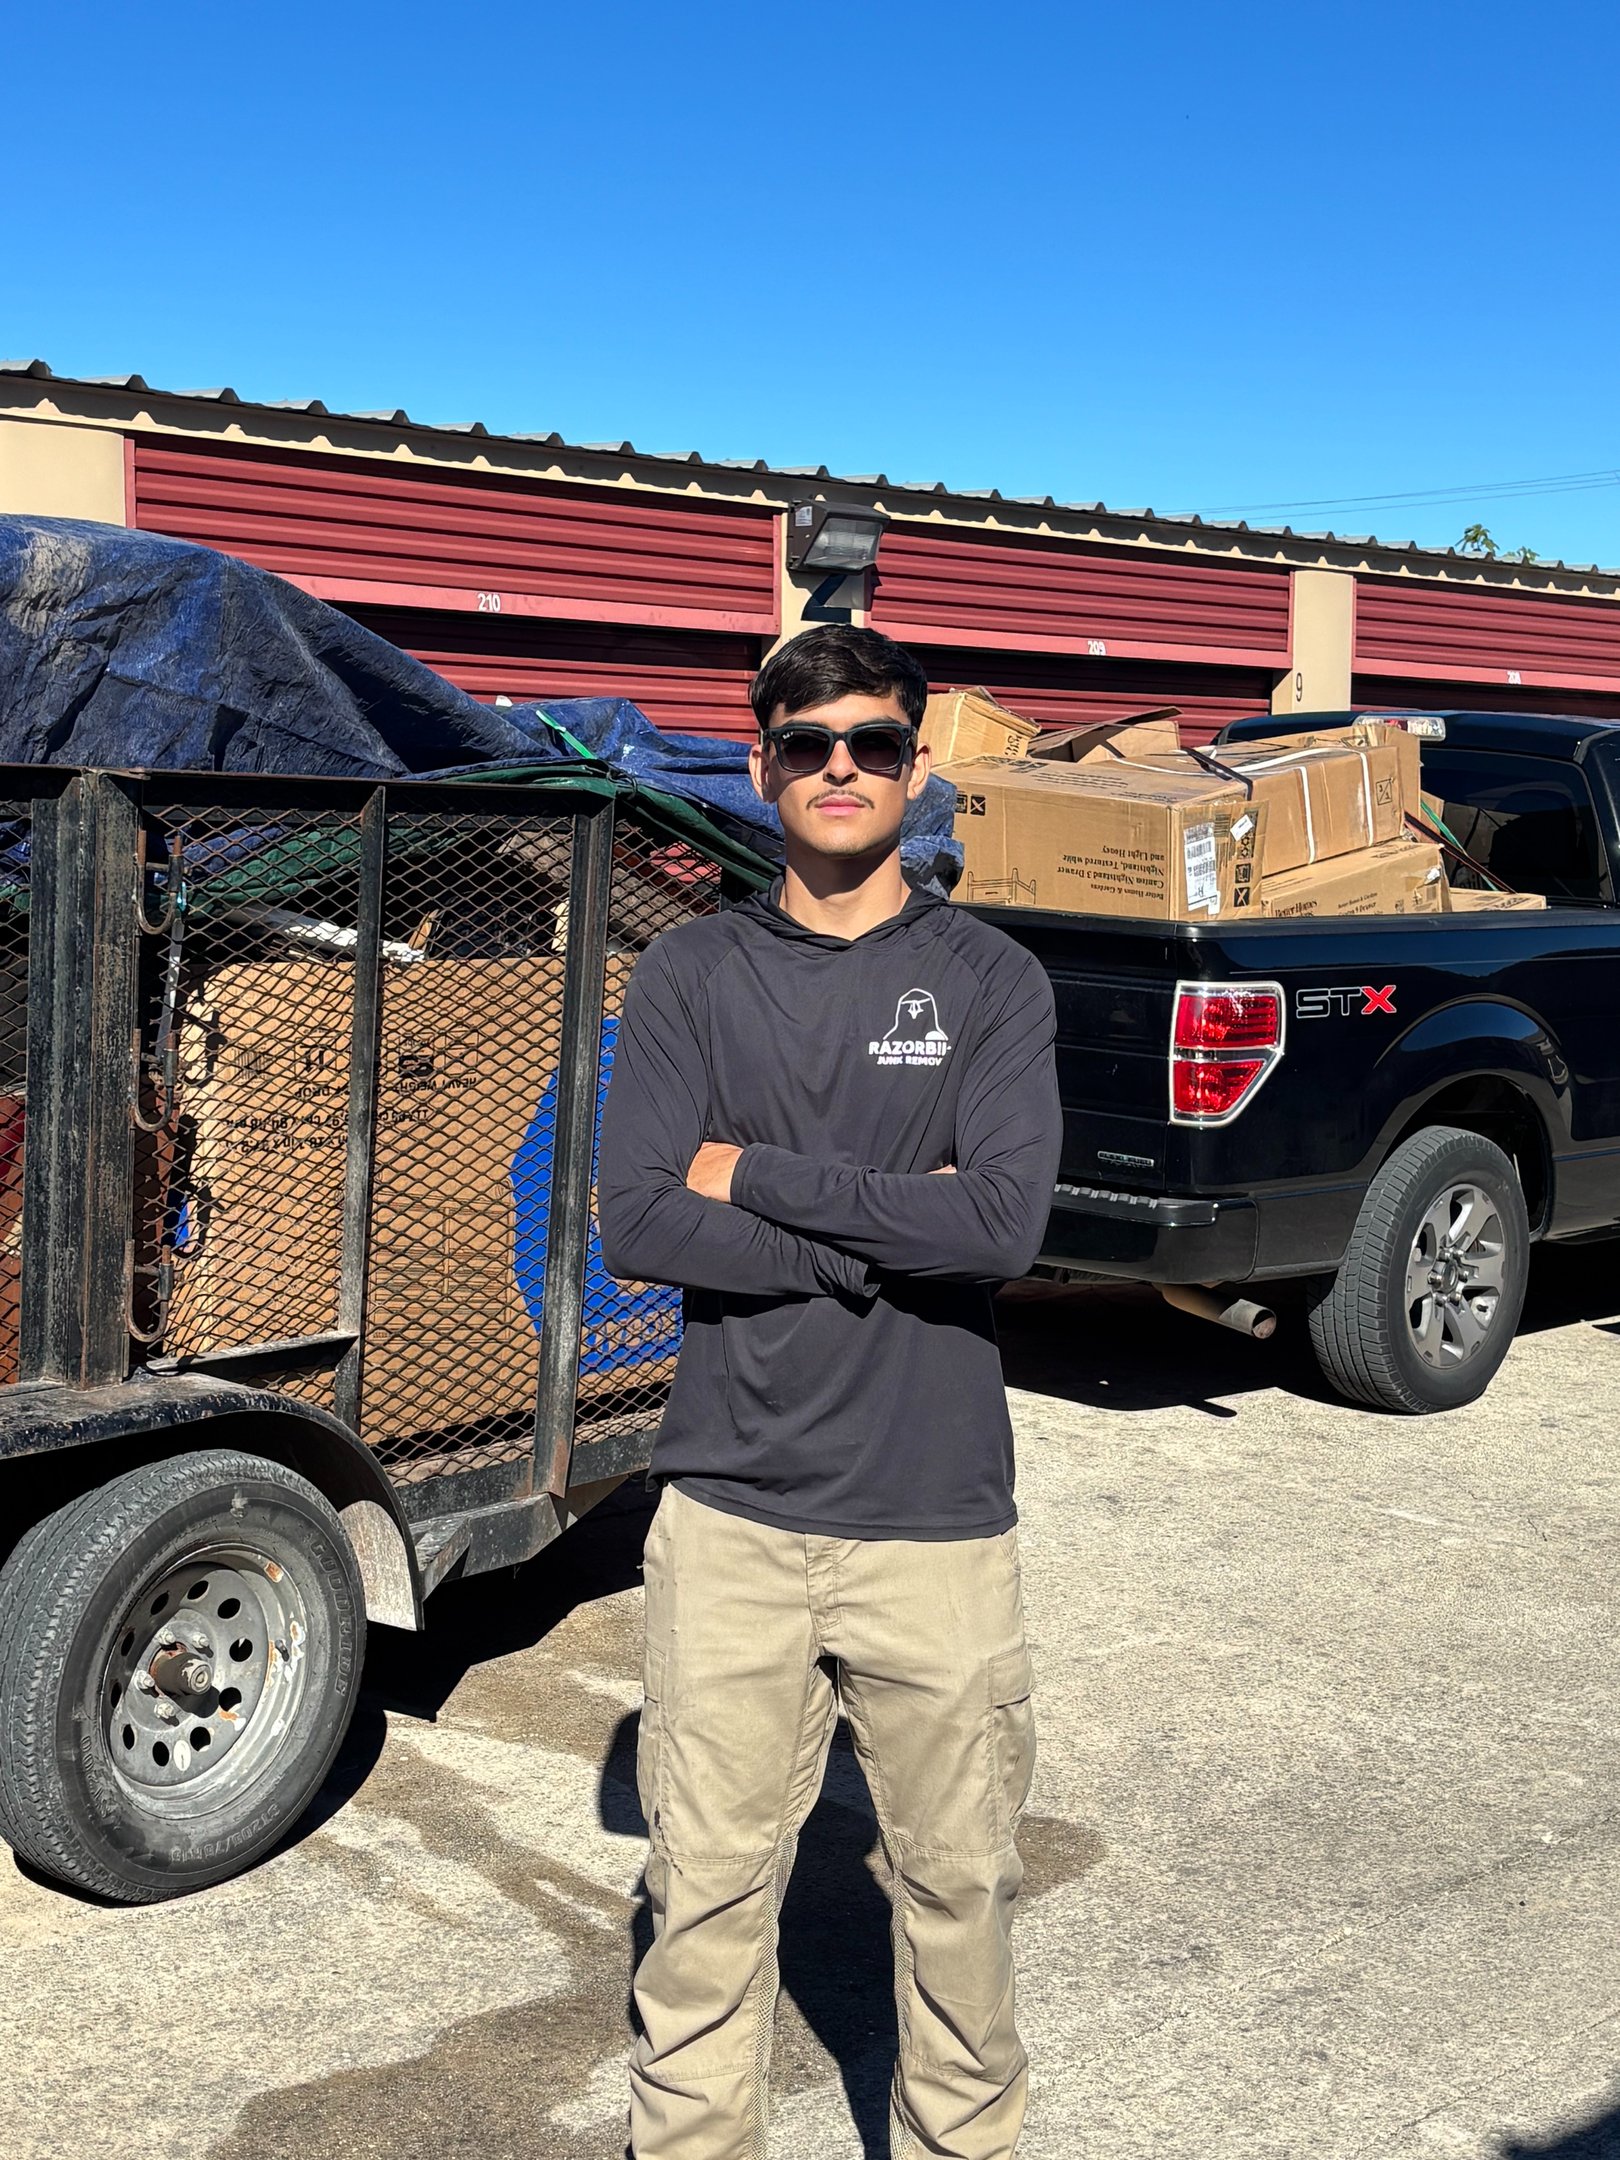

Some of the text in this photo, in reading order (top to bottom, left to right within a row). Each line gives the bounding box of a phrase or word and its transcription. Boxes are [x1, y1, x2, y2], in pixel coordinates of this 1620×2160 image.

[477, 592, 501, 613] 210
[1295, 672, 1303, 702] 9
[1084, 857, 1119, 870] Textured
[1101, 845, 1165, 862] and Light Honey
[1056, 866, 1164, 889] Canton Nightstand 3 Drawer
[1296, 985, 1397, 1019] STX
[877, 1056, 903, 1065] JUNK
